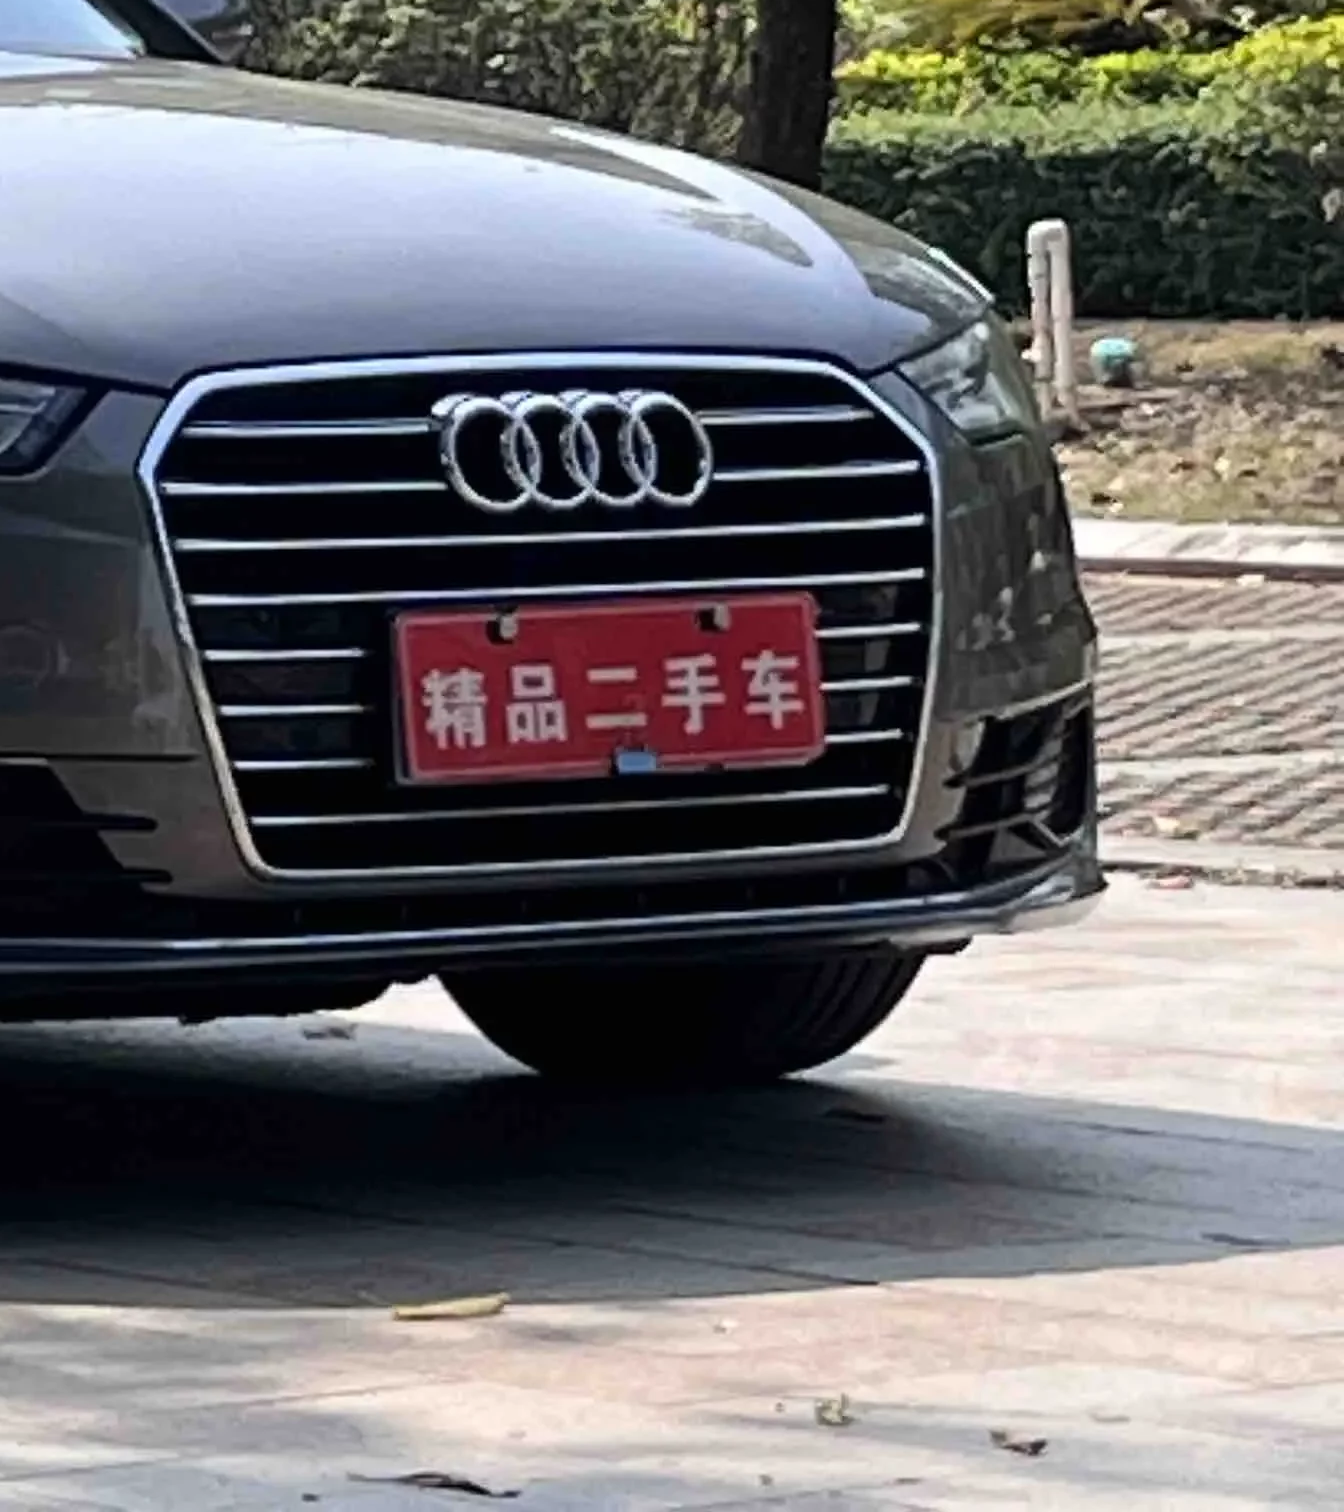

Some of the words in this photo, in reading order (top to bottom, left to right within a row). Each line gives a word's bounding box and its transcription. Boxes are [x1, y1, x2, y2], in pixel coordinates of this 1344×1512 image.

[421, 649, 805, 749] 精品二手车
